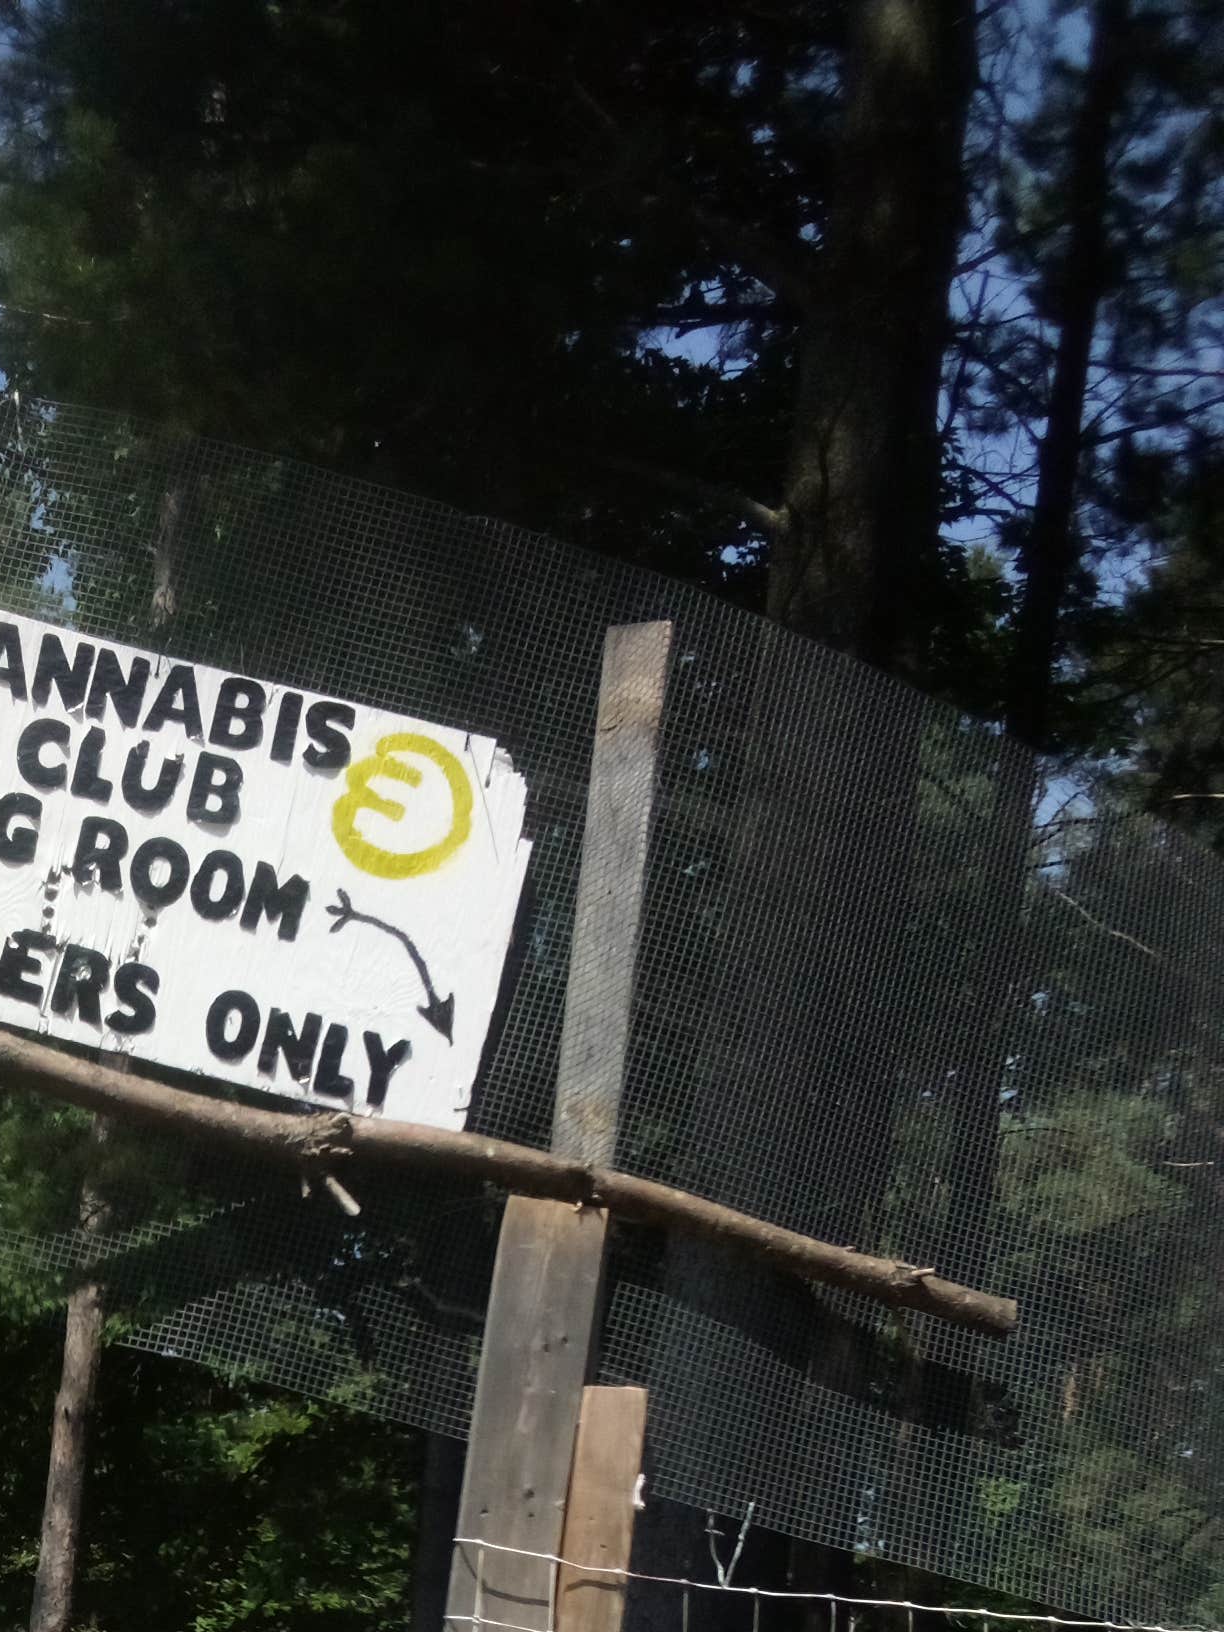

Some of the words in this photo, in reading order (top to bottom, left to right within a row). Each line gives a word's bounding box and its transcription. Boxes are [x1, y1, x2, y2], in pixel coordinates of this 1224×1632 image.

[15, 718, 244, 827] CLUB
[66, 817, 311, 942] ROOM
[205, 989, 413, 1109] ONLY
